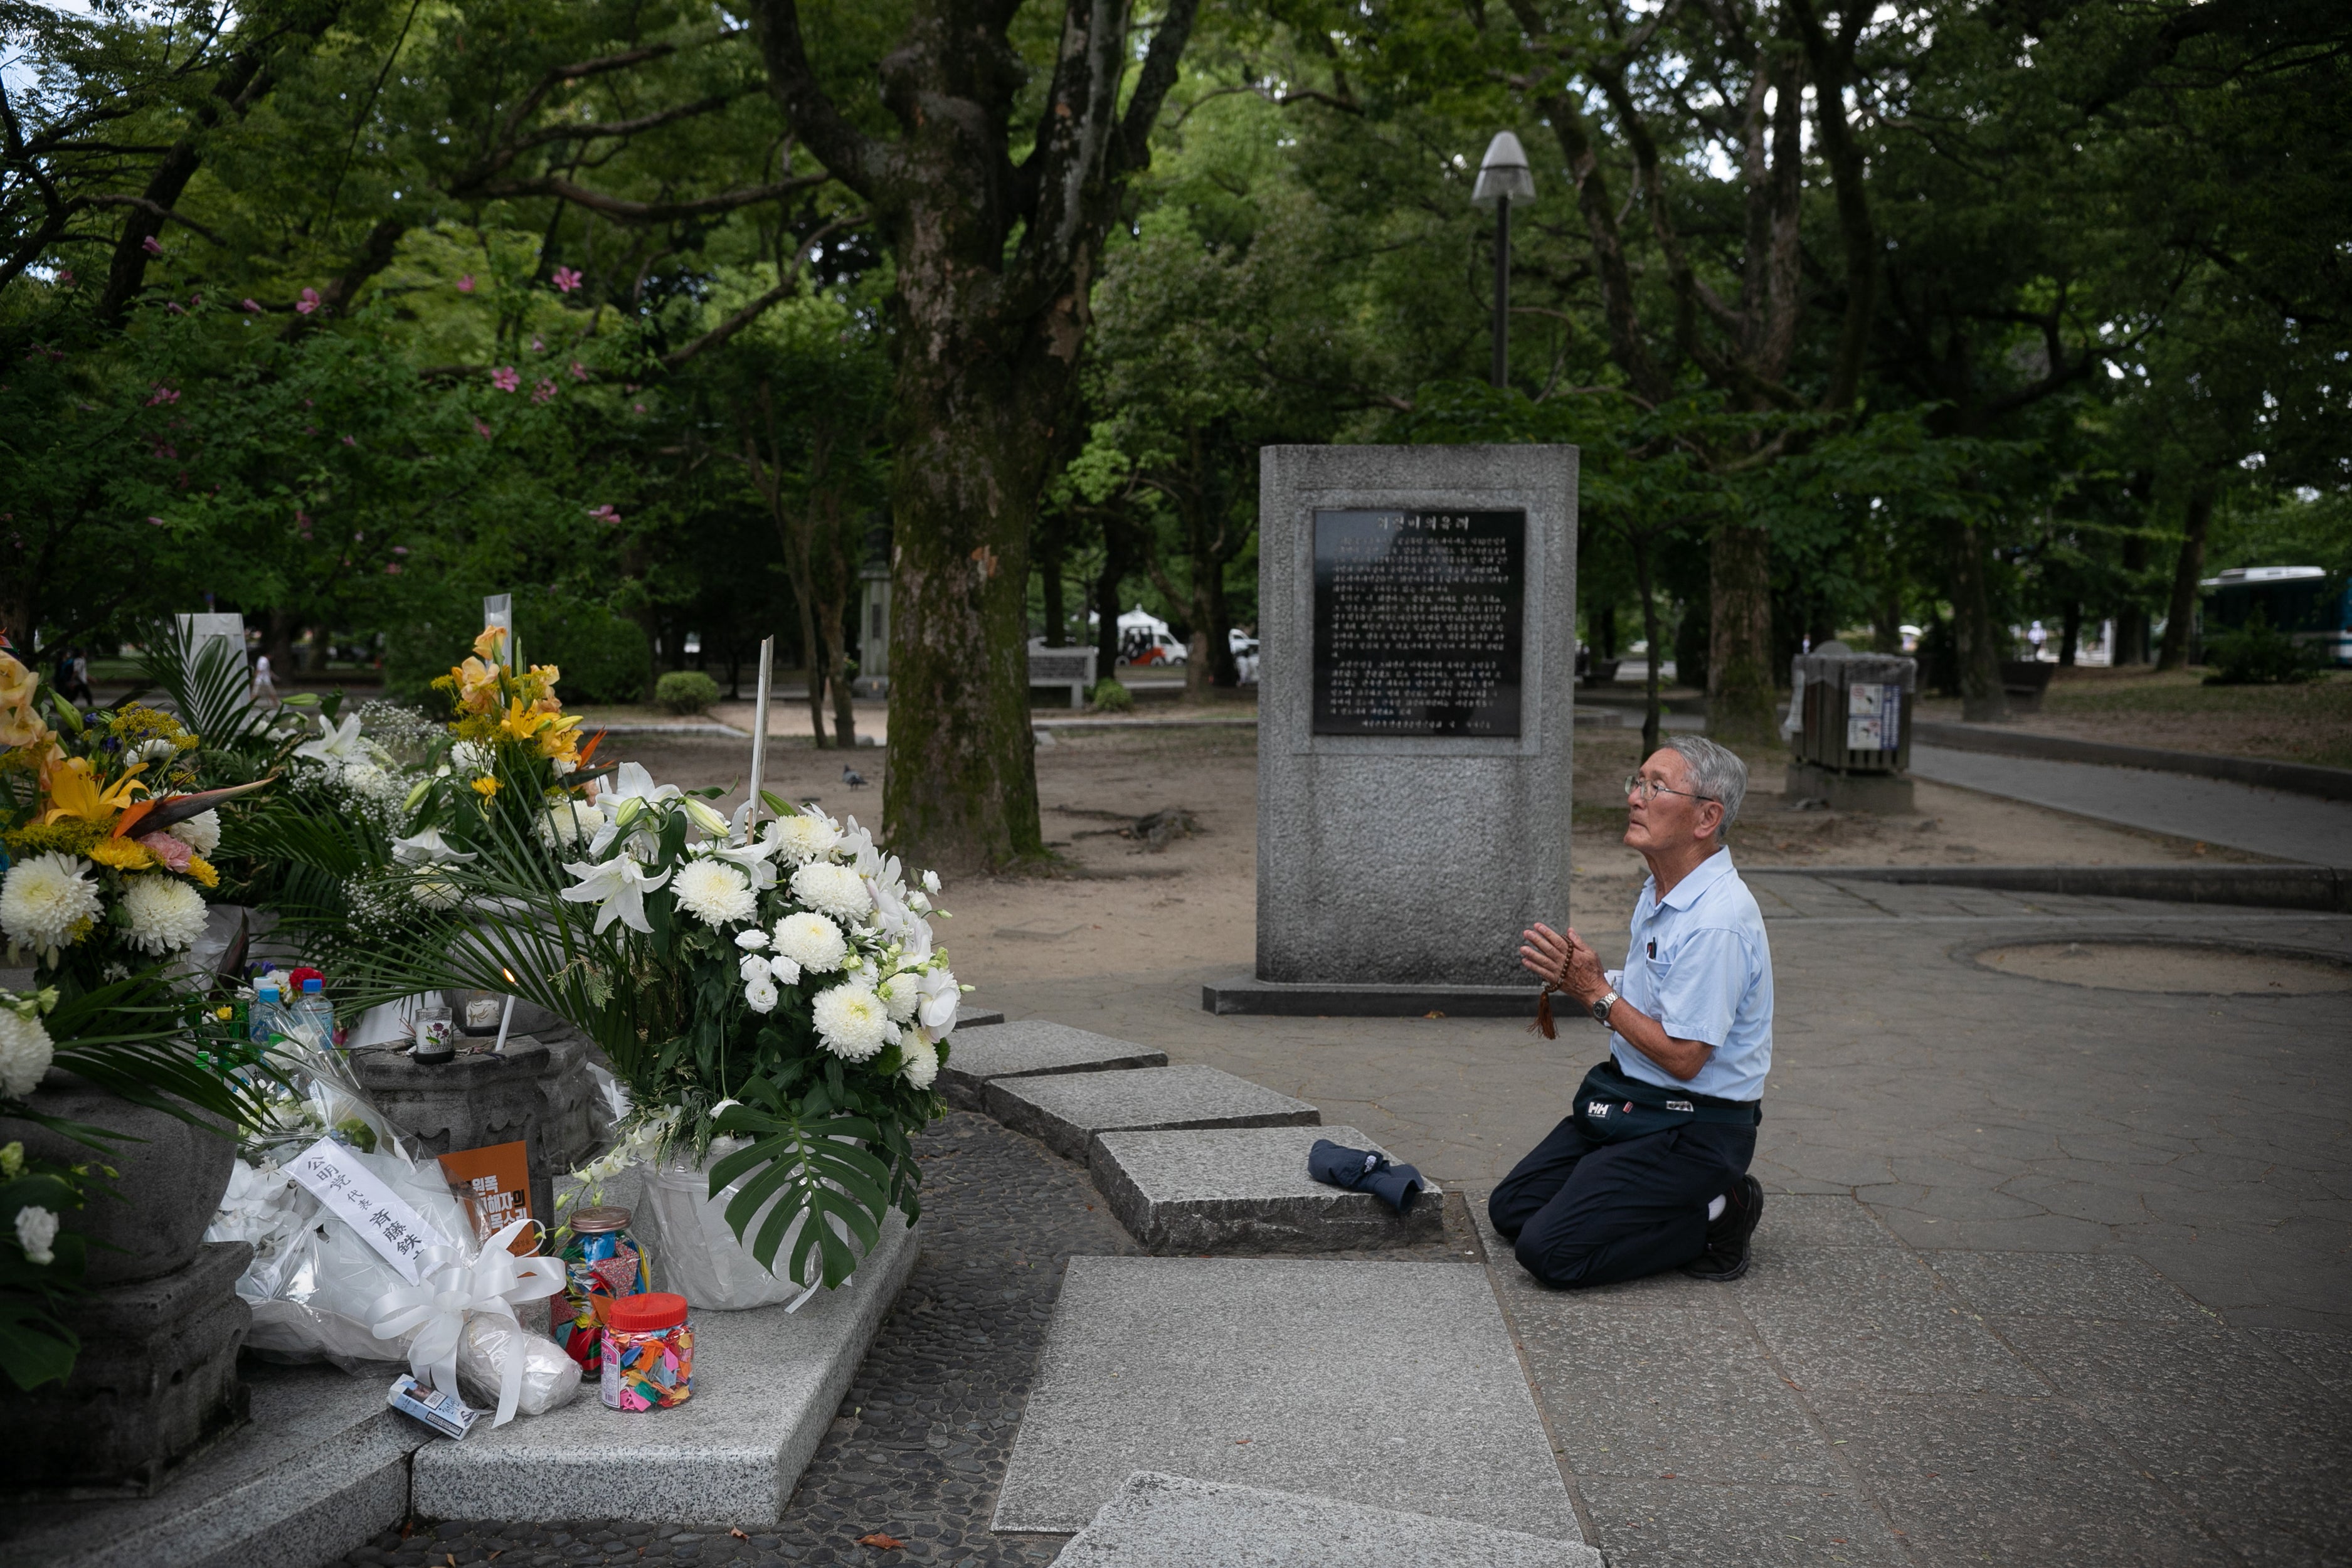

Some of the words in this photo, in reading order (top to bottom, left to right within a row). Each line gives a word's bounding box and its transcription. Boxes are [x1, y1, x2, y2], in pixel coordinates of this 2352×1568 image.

[1588, 1101, 1609, 1115] HH
[307, 1155, 351, 1192] 公明党
[347, 1189, 373, 1211] 代表
[472, 1175, 499, 1196] 원폭
